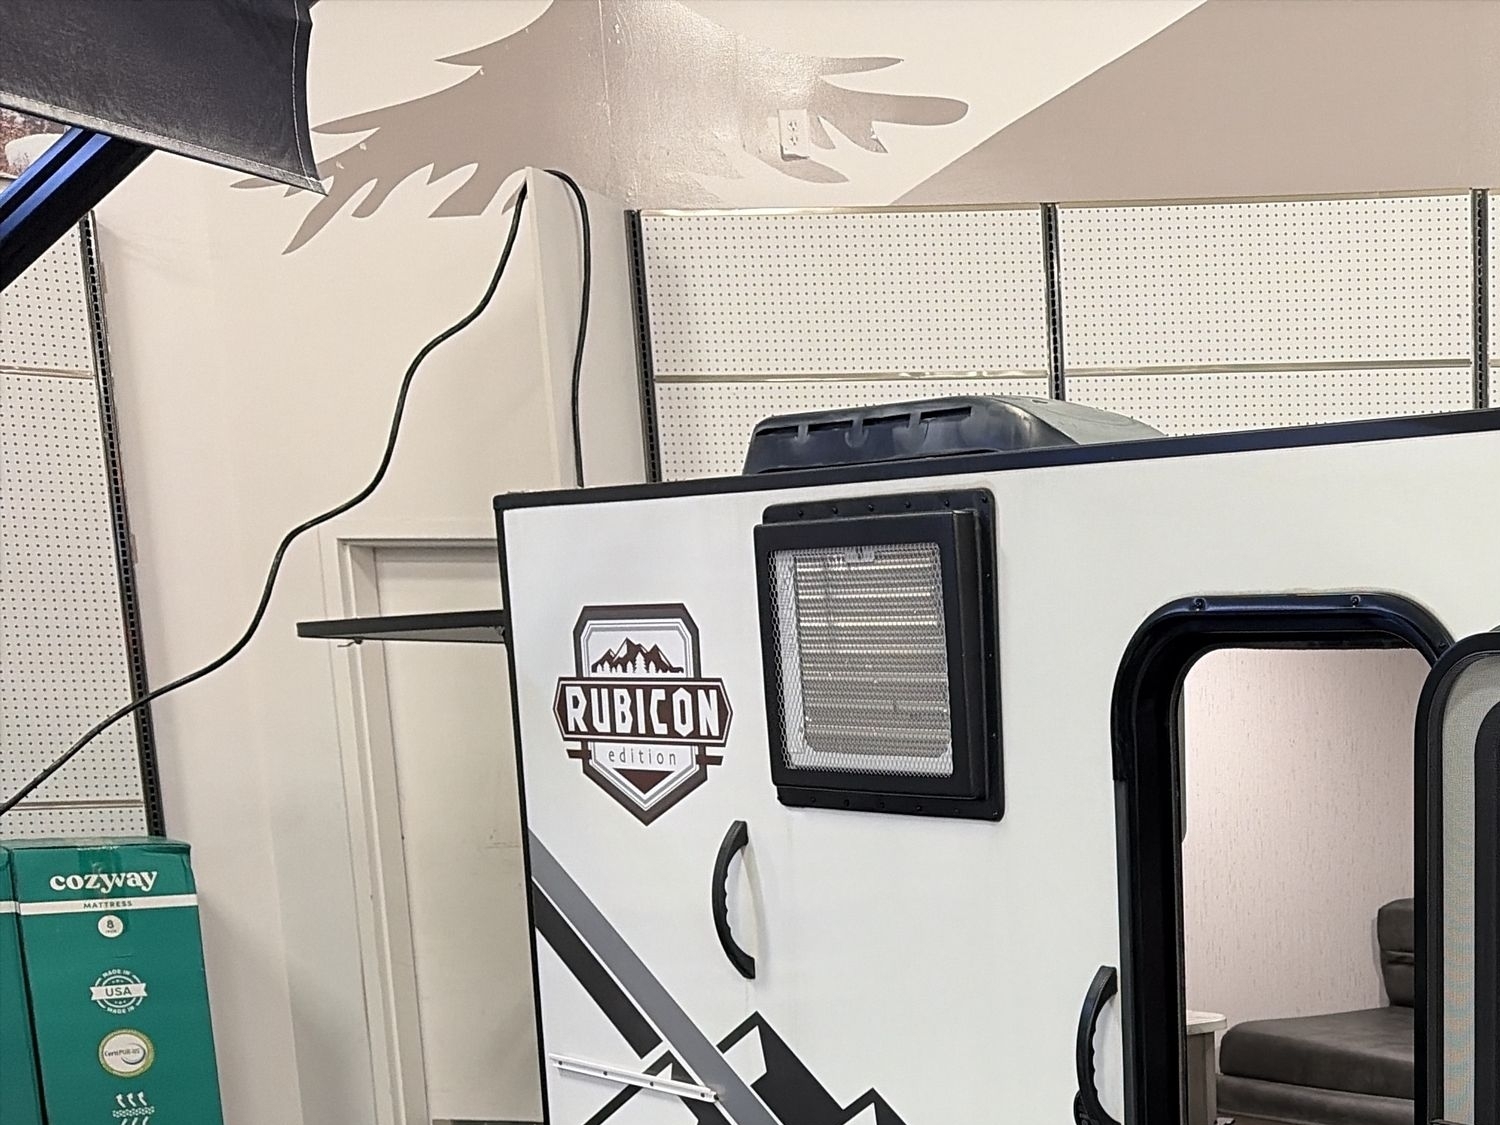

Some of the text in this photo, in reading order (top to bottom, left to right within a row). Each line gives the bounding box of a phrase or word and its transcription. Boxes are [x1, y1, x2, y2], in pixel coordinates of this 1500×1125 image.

[565, 686, 720, 738] RUBICON
[608, 749, 676, 765] edition
[50, 871, 158, 894] cozyway
[83, 900, 133, 909] MATTRESS
[106, 920, 115, 929] 8
[105, 987, 132, 997] USA
